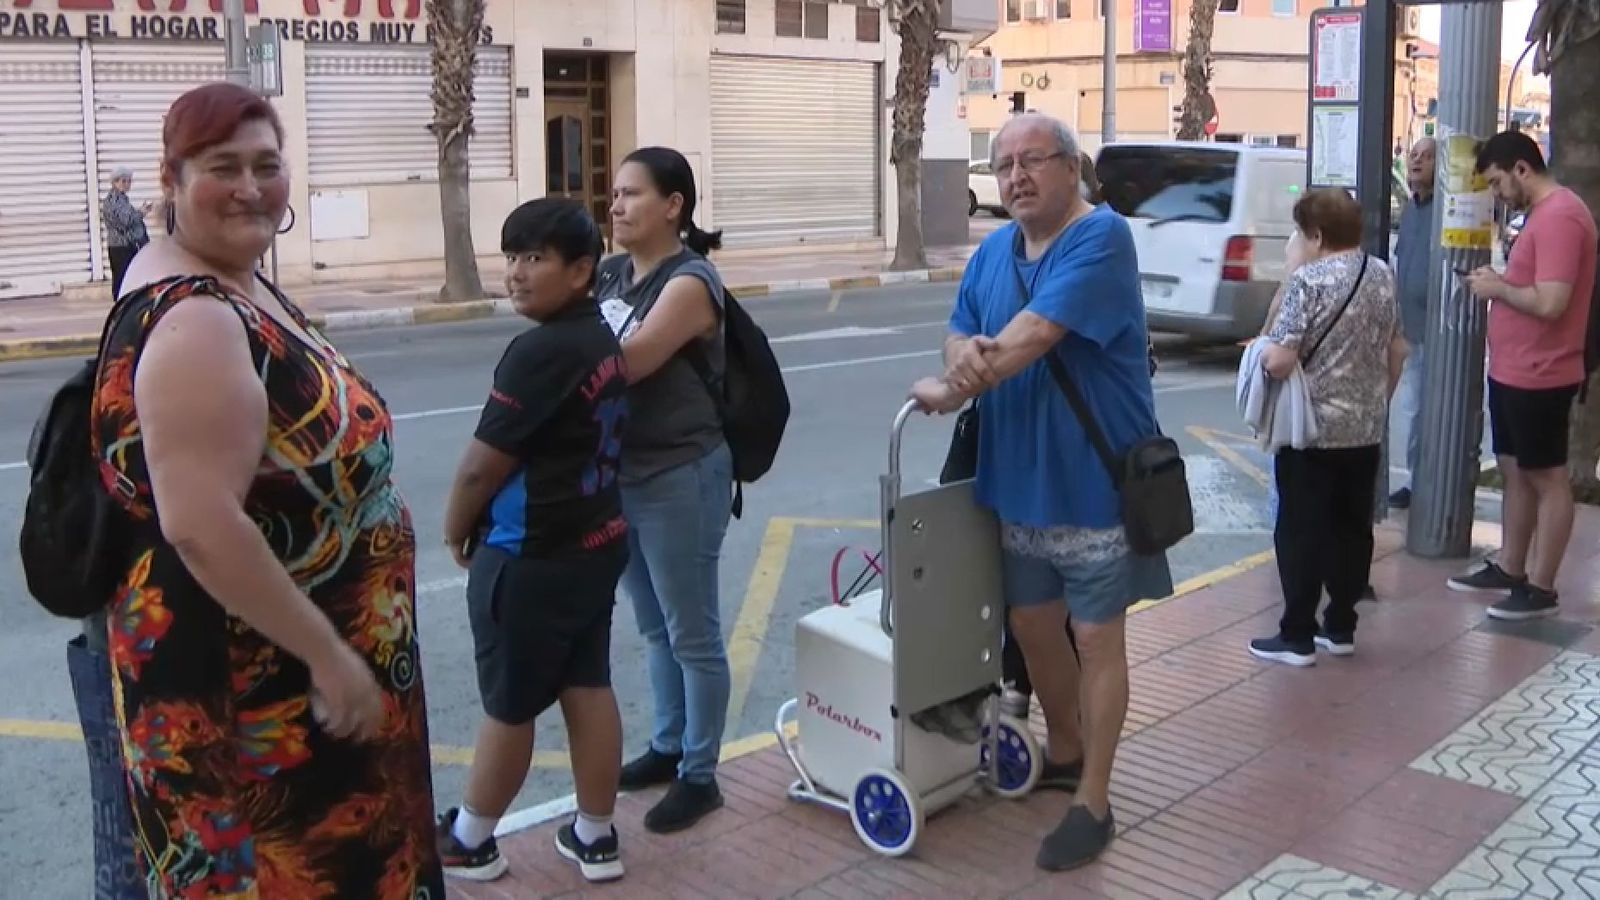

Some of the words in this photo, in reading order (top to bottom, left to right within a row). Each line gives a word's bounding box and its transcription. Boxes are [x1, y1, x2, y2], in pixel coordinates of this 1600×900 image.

[0, 12, 71, 37] PARA
[85, 14, 117, 37] EL
[131, 15, 218, 39] HOGAR
[260, 18, 359, 41] RECIOS
[369, 22, 415, 43] MUY
